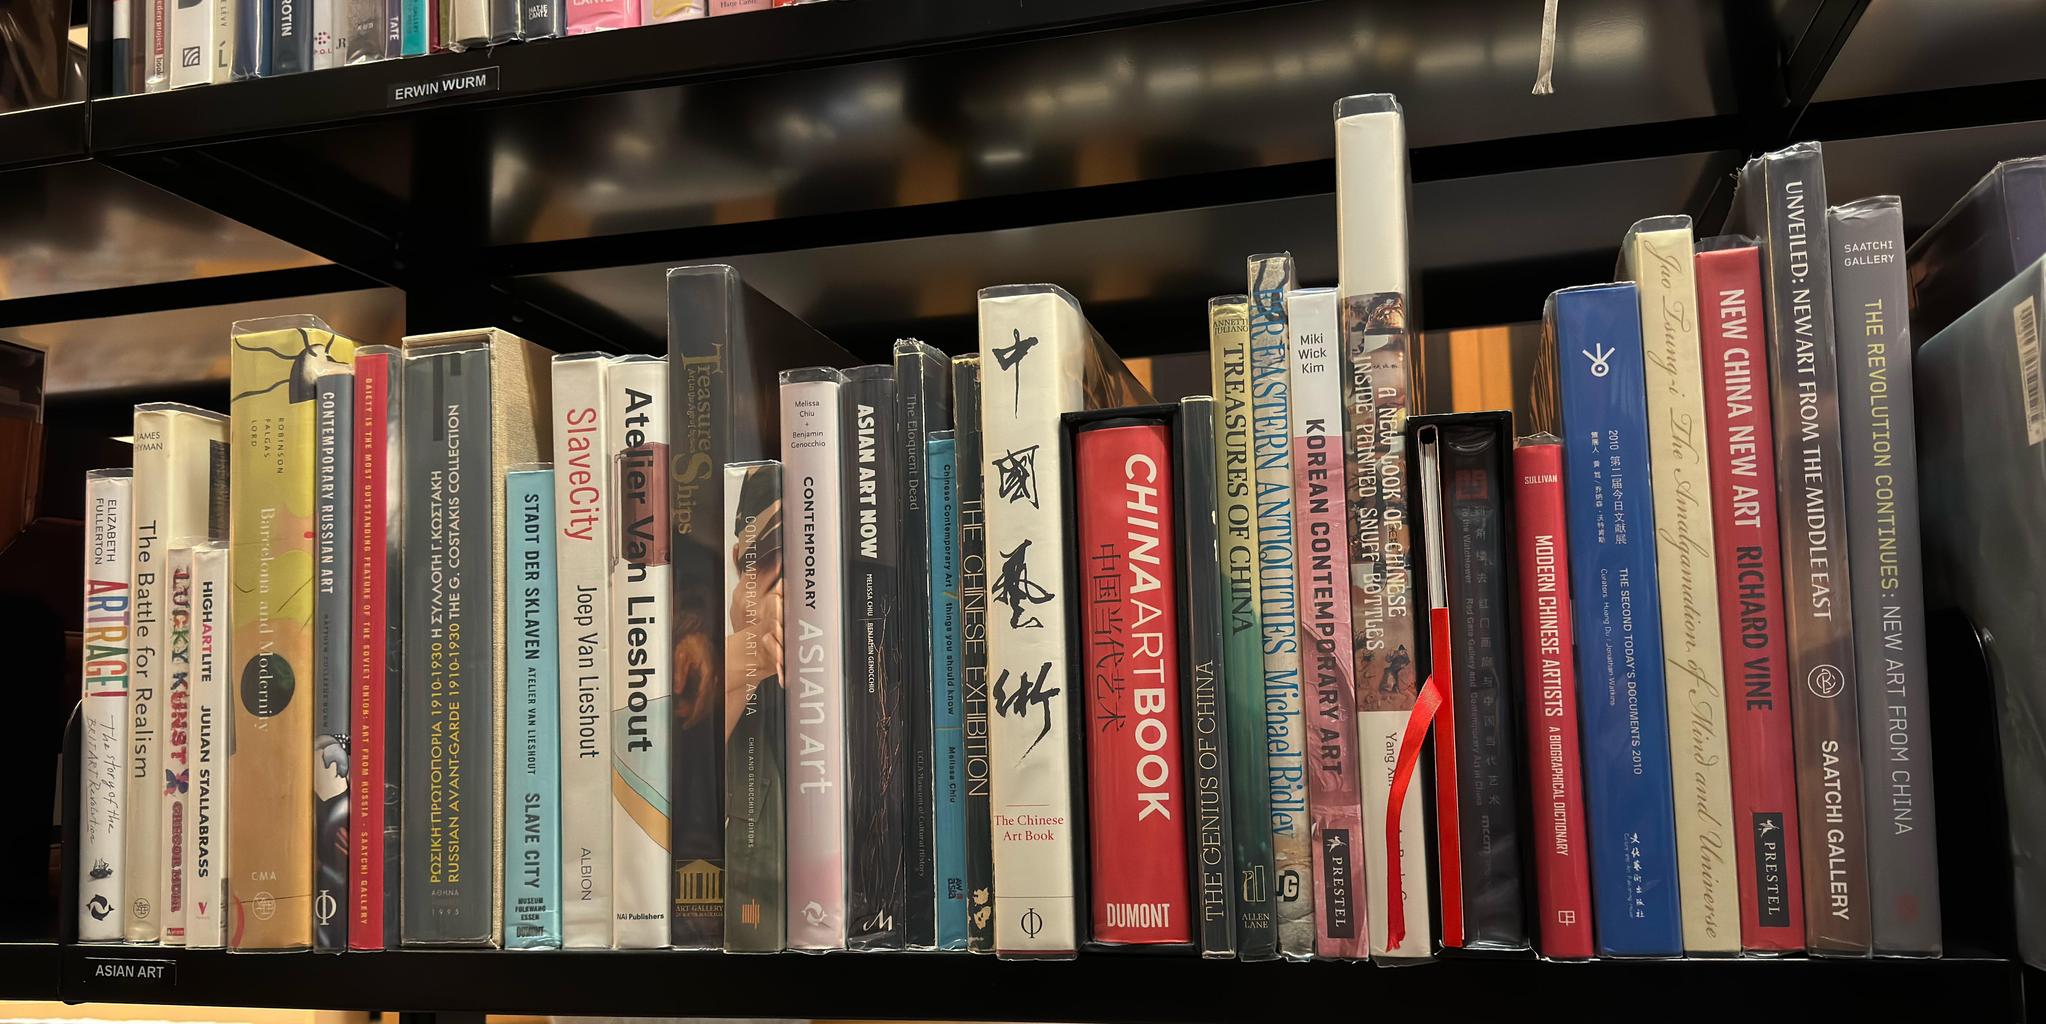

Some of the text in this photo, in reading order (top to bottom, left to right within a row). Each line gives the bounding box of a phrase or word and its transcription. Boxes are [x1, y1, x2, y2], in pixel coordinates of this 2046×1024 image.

[389, 16, 400, 41] TATE
[395, 74, 487, 100] ERWIN WURM
[1844, 240, 1893, 253] SAATCHI
[1844, 253, 1895, 266] GALLERY
[1298, 347, 1327, 360] Wick
[1300, 333, 1323, 345] Miki
[1302, 363, 1324, 374] Kim
[136, 431, 161, 440] JAMES
[792, 431, 823, 440] Benjamin
[794, 400, 820, 408] Melissa
[1670, 407, 1699, 464] The
[1785, 180, 1832, 622] UNVEILED: NEW ART FROM THE MIDDLE EAST
[134, 442, 163, 452] HYMAN
[277, 417, 285, 474] ROBINSON
[564, 407, 600, 541] SlaveCity
[671, 343, 724, 535] Treasure Ships
[791, 440, 825, 449] Genocchio
[906, 394, 919, 510] The Eloquent Dead
[1608, 429, 1619, 450] 2010
[320, 392, 335, 594] CONTEMPORARY RUSSIAN ART
[857, 404, 877, 558] ASIAN ART NOW
[1224, 343, 1253, 636] TREASURES OF CHINA
[1524, 474, 1558, 485] SULLIVAN
[1719, 288, 1772, 711] NEW CHINA NEW ART RICHARD VINE
[95, 498, 104, 565] FULLERTON
[106, 499, 117, 562] ELIZABETH
[804, 476, 816, 609] CONTEMPORARY
[1659, 468, 1709, 652] Amalgamation
[1865, 299, 1914, 835] THE REVOLUTION CONTINUES: NEW ART FROM CHINA
[431, 555, 442, 625] ΣΥΛΛΟΓΗ
[524, 494, 539, 660] STADT DER SKLAVEN
[625, 387, 656, 753] Atelier Van Lieshout
[1306, 418, 1342, 775] KOREAN CONTEMPORARY ART
[84, 579, 129, 698] ARTRAGE!
[134, 520, 157, 778] The Battle for Realism
[254, 507, 276, 732] Barcelona and Modernity
[448, 404, 460, 883] RUSSIAN AVANT-GARDE 1910-1930 THE G. COSTAKIS COLLECTION
[745, 516, 757, 716] CONTEMPORARY ART IN ASIA
[962, 494, 988, 796] THE CHINESE EXHIBITION
[1092, 543, 1127, 733] 中国当代艺术
[1535, 535, 1563, 716] MODERN CHINESE ARTISTS
[431, 642, 442, 716] 1910-1930
[574, 585, 599, 759] Joep Van Lieshout
[1619, 568, 1643, 774] THE SECOND TODAY'S DOCUMENTS 2010
[1668, 659, 1720, 697] of
[527, 667, 536, 775] ATELIER VAN LIESHOUT
[1264, 668, 1302, 757] Michael
[1384, 732, 1397, 763] Yang
[1689, 689, 1720, 766] Mind
[100, 714, 122, 834] The story of the
[199, 705, 211, 877] JULIAN STALLABRASS
[431, 721, 442, 823] ΠΡΩΤΟΠΟΡΙΑ
[1196, 659, 1224, 921] THE GENIUS OF CHINA
[1549, 735, 1564, 799] BIOGRAPHICAL
[1695, 772, 1722, 826] and
[431, 827, 442, 883] ΡΩΣΙΚΗ
[524, 793, 540, 888] SLAVE CITY
[994, 814, 1064, 826] The Chinese
[1003, 829, 1054, 841] Art Book
[1553, 802, 1568, 856] DICTIONARY
[1821, 740, 1850, 920] SAATCHI GALLERY
[251, 871, 277, 881] CMA
[580, 847, 591, 901] ALBION
[1332, 856, 1346, 927] PRESTEL
[1699, 832, 1724, 938] Universe
[1764, 842, 1780, 915] PRESTEL
[1106, 903, 1170, 928] DUMONT
[1242, 913, 1269, 921] ALLEN
[1244, 921, 1268, 929] LANE
[95, 965, 164, 979] ASIAN ART
